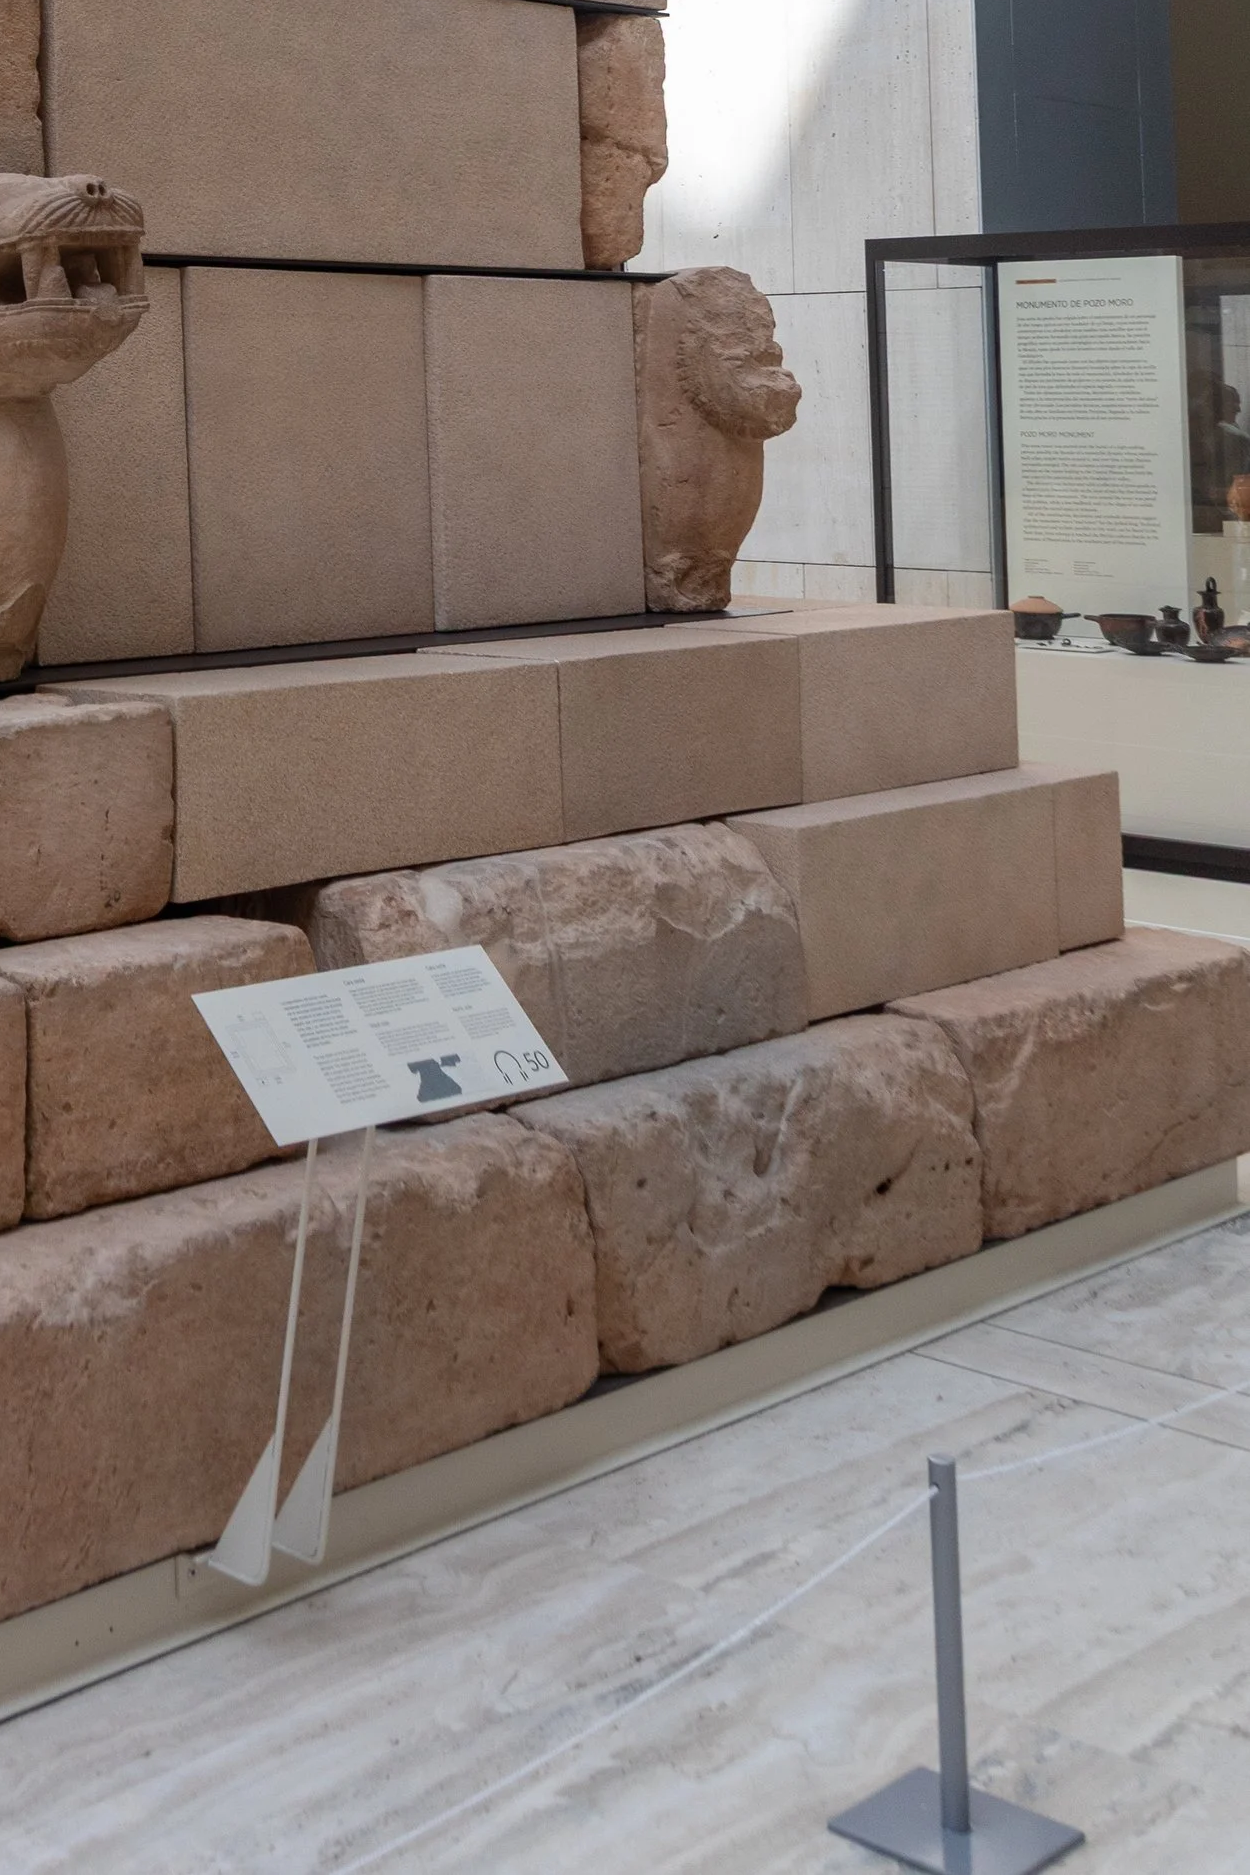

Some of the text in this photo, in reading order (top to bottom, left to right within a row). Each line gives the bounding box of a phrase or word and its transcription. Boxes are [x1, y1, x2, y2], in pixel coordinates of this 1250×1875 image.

[1015, 298, 1134, 309] MONUMENTO DE POZO MORO
[1020, 430, 1095, 439] POZO MORO MONUMENT
[523, 1050, 550, 1072] 50
